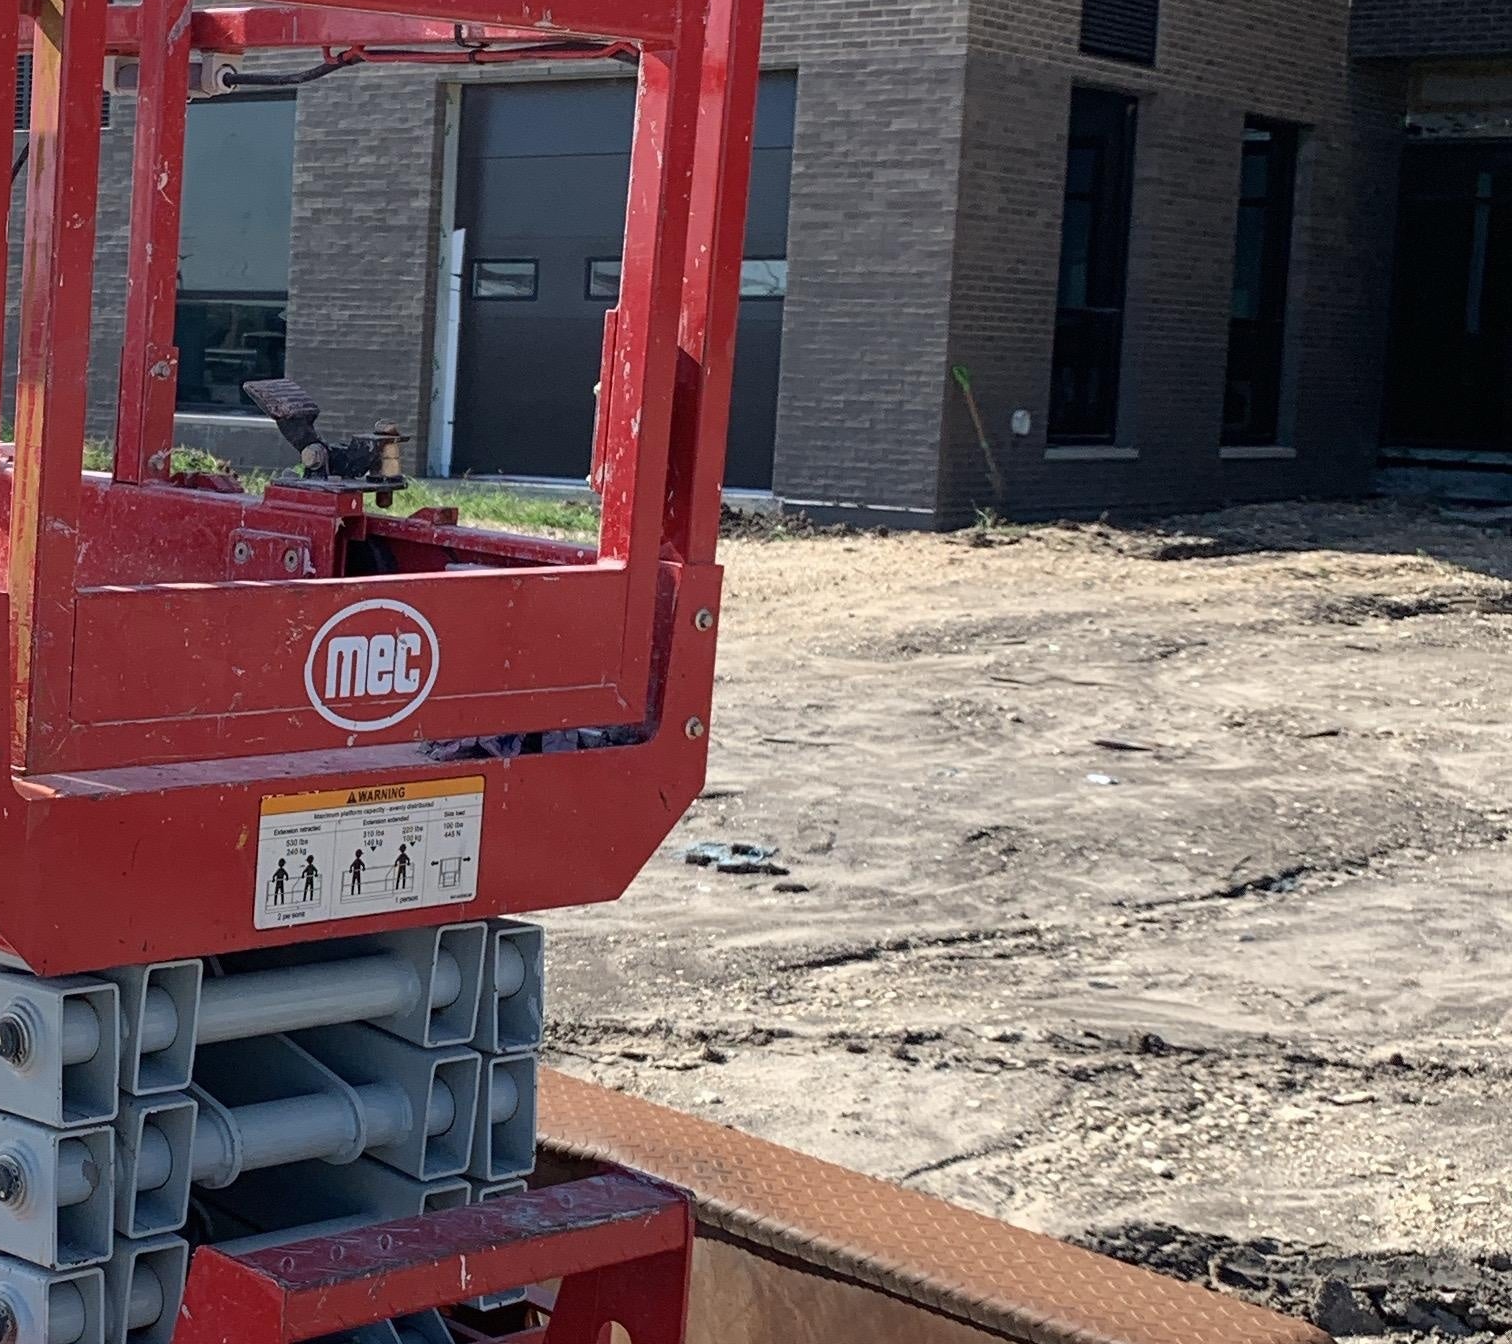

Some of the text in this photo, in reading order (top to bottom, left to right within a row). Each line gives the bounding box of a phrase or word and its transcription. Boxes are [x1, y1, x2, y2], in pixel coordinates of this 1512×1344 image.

[358, 787, 406, 803] WARNING
[340, 808, 362, 818] platform
[363, 806, 385, 815] capacity
[406, 801, 434, 810] distributed
[362, 814, 410, 827] Extension extended
[273, 825, 322, 836] Extension retracted
[375, 829, 385, 837] lbs
[299, 838, 309, 846] lbs
[375, 838, 384, 846] kg
[414, 834, 422, 842] kg
[300, 847, 307, 855] kg
[399, 895, 419, 904] person
